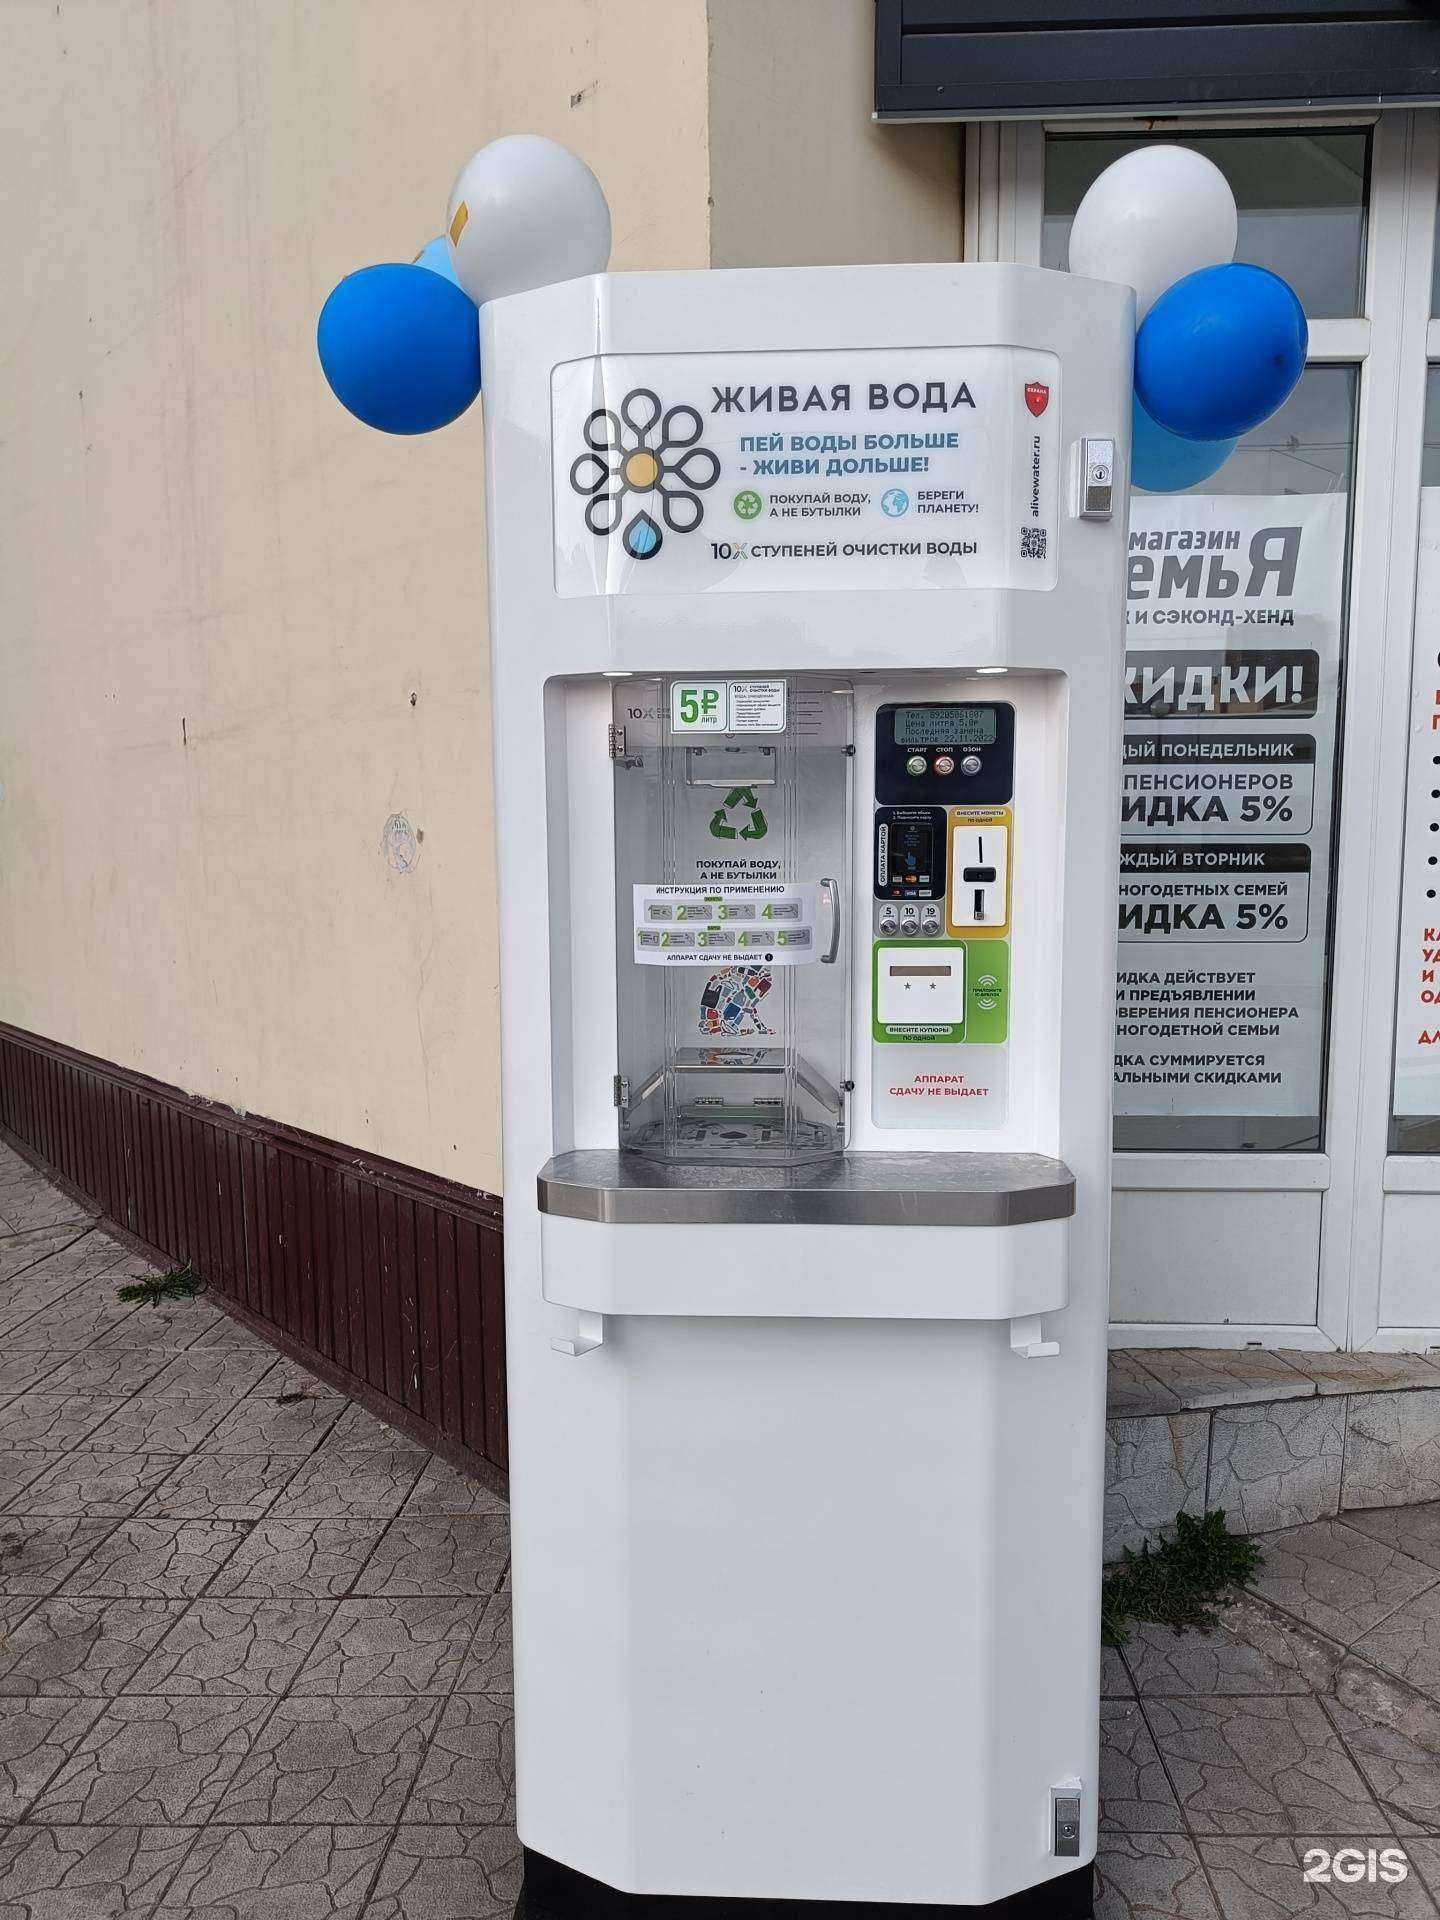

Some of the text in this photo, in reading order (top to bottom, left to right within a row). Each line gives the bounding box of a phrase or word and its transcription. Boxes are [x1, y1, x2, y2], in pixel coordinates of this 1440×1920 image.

[711, 382, 976, 413] ЖИВАЯ ВОДА
[741, 432, 959, 453] ПЕЙ ВОДЫ БОЛЬШЕ
[753, 459, 820, 475] ЖИВИ
[826, 456, 929, 476] ДОЛЬШЕ!
[1030, 435, 1041, 518] alivewater.ru
[770, 492, 871, 505] ПОКУПАЙ ВОДУ,
[918, 490, 964, 500] БЕРЕГИ
[770, 507, 861, 517] А НЕ БУТЫЛКИ
[918, 503, 979, 514] ПЛАНЕТУ!
[1129, 530, 1240, 550] магазин
[751, 541, 837, 558] СТУПЕНЕЙ
[843, 542, 921, 556] ОЧИСТКИ
[926, 541, 977, 557] ВОДЫ
[1135, 610, 1148, 625] И
[1152, 609, 1295, 626] СЭКОНД-ХЕНД
[701, 715, 718, 725] литр
[905, 719, 926, 728] Цена
[905, 727, 950, 736] Последняя
[1161, 743, 1295, 759] ПОНЕДЕЛЬНИК
[1123, 774, 1293, 790] ПЕНСИОНЕРОВ
[1121, 795, 1293, 827] ИДКА 5%
[696, 858, 781, 869] ПОКУПАЙ ВОДУ,
[1182, 852, 1266, 866] ВТОРНИК
[700, 872, 777, 880] А НЕ БУТЫЛКИ
[656, 885, 785, 895] ИНСТРУКЦИЯ ПО ПРИМЕНЕНИЮ
[1119, 881, 1288, 898] НОГОДЕТНЫХ СЕМЕЙ
[676, 905, 687, 920] 2
[718, 905, 728, 920] 3
[761, 904, 773, 919] 4
[905, 907, 914, 915] 10
[926, 907, 935, 915] 19
[1118, 903, 1288, 934] ИДКА 5%
[661, 931, 671, 947] 2
[698, 931, 708, 947] 3
[738, 931, 748, 946] 4
[777, 930, 788, 946] 5
[699, 954, 721, 962] СДАЧУ
[1116, 969, 1256, 986] ИДКА ДЕЙСТВУЕТ
[1422, 969, 1434, 983] И
[1116, 989, 1256, 1003] И ПРЕДЪЯВЛЕНИИ
[1116, 1007, 1299, 1018] ВЕРЕНИЯ ПЕНСИОНЕРА
[1117, 1022, 1280, 1038] НОГОДЕТНОЙ СЕМЬИ
[1149, 1054, 1265, 1066] СУММИРУЕТСЯ
[914, 1075, 965, 1083] АППАРАТ
[1193, 1072, 1282, 1085] СКИДКАМИ
[889, 1087, 989, 1097] СДАЧУ НЕ ВЫДАЕТ
